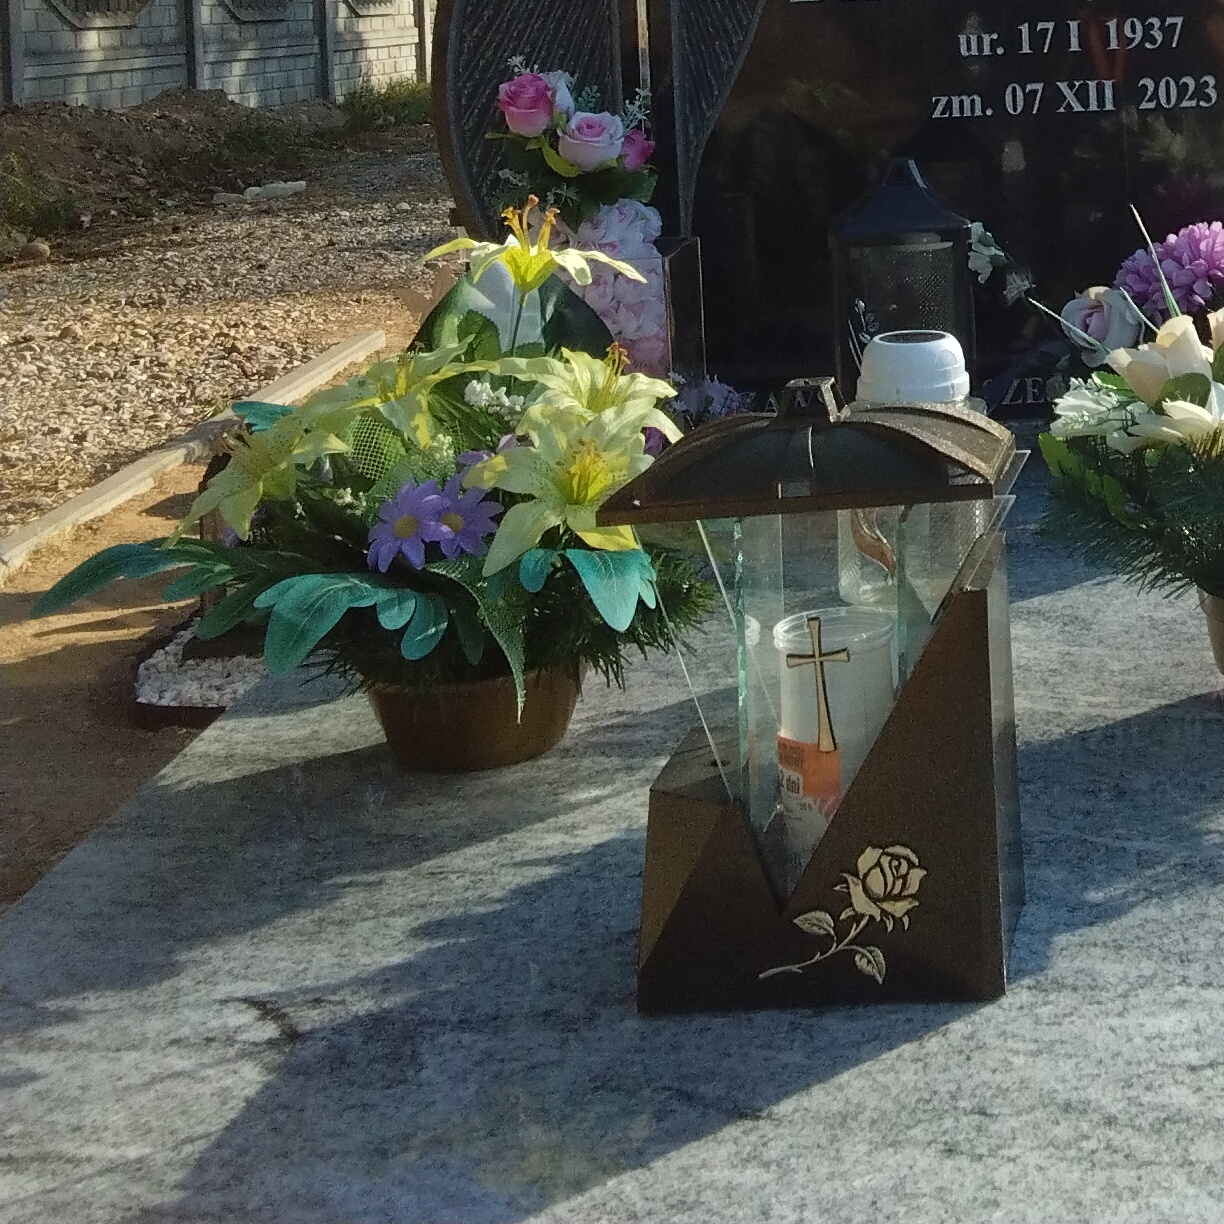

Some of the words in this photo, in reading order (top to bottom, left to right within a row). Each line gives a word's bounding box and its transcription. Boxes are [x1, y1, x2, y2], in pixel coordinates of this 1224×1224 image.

[957, 32, 1004, 57] ur.
[1017, 21, 1055, 54] 17
[1067, 19, 1082, 53] I
[1105, 15, 1184, 51] 1937
[931, 93, 993, 119] zm.
[1004, 82, 1044, 116] 07
[1055, 79, 1116, 114] XII
[1137, 74, 1218, 110] 2023
